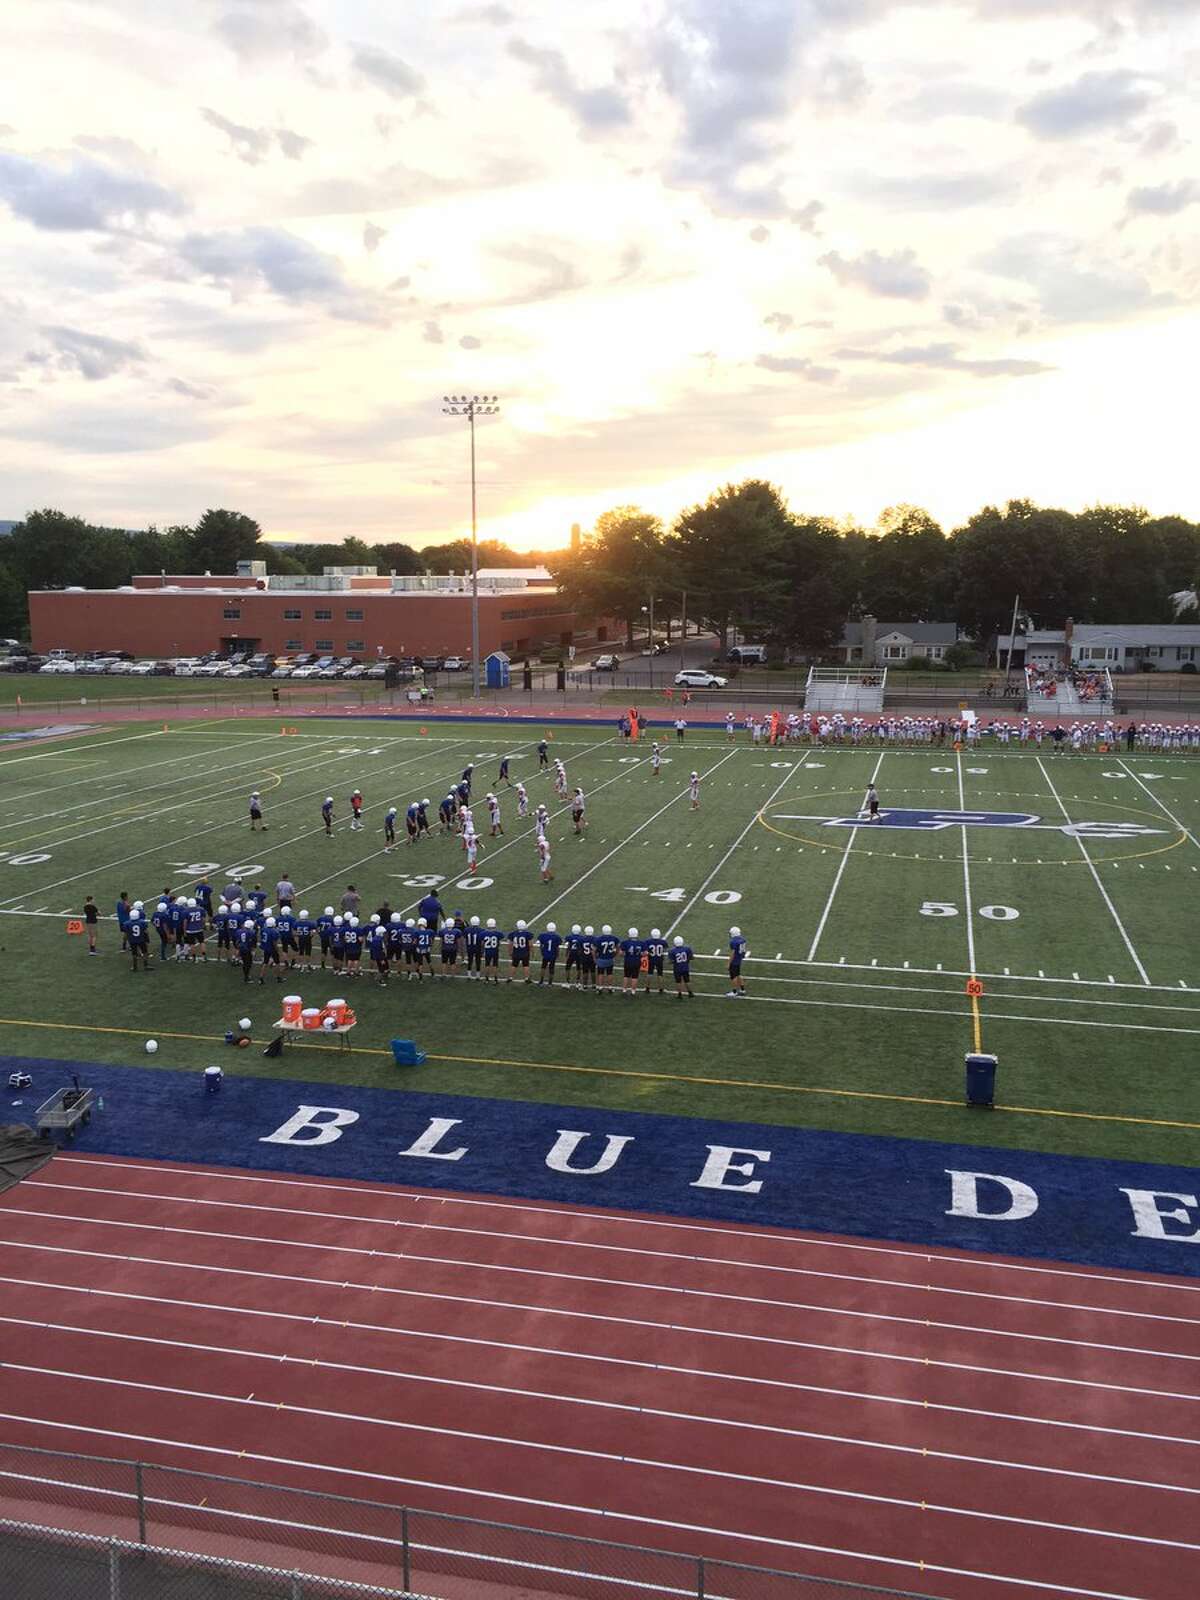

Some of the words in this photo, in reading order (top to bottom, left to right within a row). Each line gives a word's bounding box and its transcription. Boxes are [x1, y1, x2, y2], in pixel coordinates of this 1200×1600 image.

[402, 873, 495, 891] 30
[650, 887, 743, 905] 40
[189, 911, 202, 922] 72
[918, 901, 1021, 921] 50
[69, 921, 82, 931] 20
[131, 924, 141, 937] 9
[278, 921, 290, 932] 59
[419, 934, 429, 945] 21
[467, 932, 477, 945] 11
[484, 935, 498, 949] 28
[513, 936, 526, 948] 40
[547, 939, 552, 951] 1
[601, 941, 615, 954] 73
[648, 944, 663, 957] 30
[675, 951, 688, 963] 20
[968, 983, 981, 994] 50
